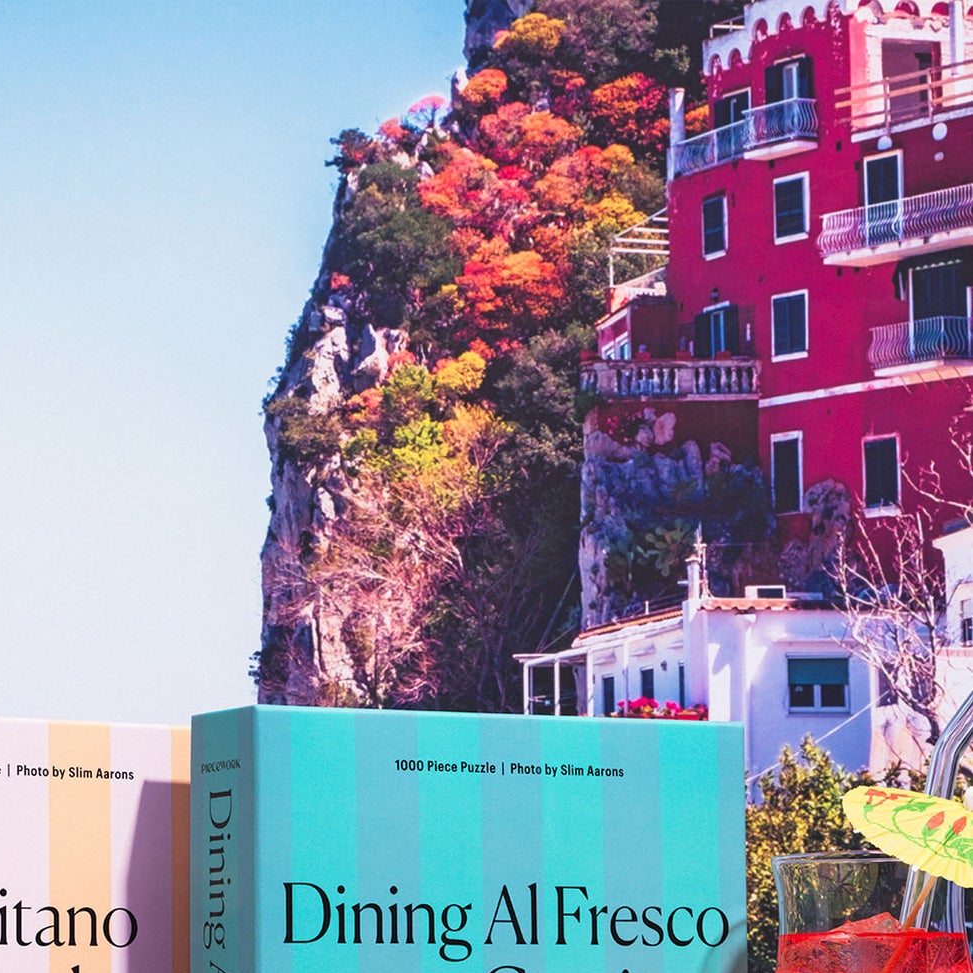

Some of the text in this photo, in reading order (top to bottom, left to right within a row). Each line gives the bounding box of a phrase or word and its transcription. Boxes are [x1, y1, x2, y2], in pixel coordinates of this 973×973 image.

[16, 765, 49, 777] Photo
[52, 765, 66, 780] by
[68, 766, 93, 779] Slim
[96, 768, 134, 780] Aarons
[395, 759, 624, 778] 1000 Piece Puzzle Photo by Slim Aarons
[202, 788, 232, 950] Dining
[282, 882, 730, 963] Dining Al Fresco
